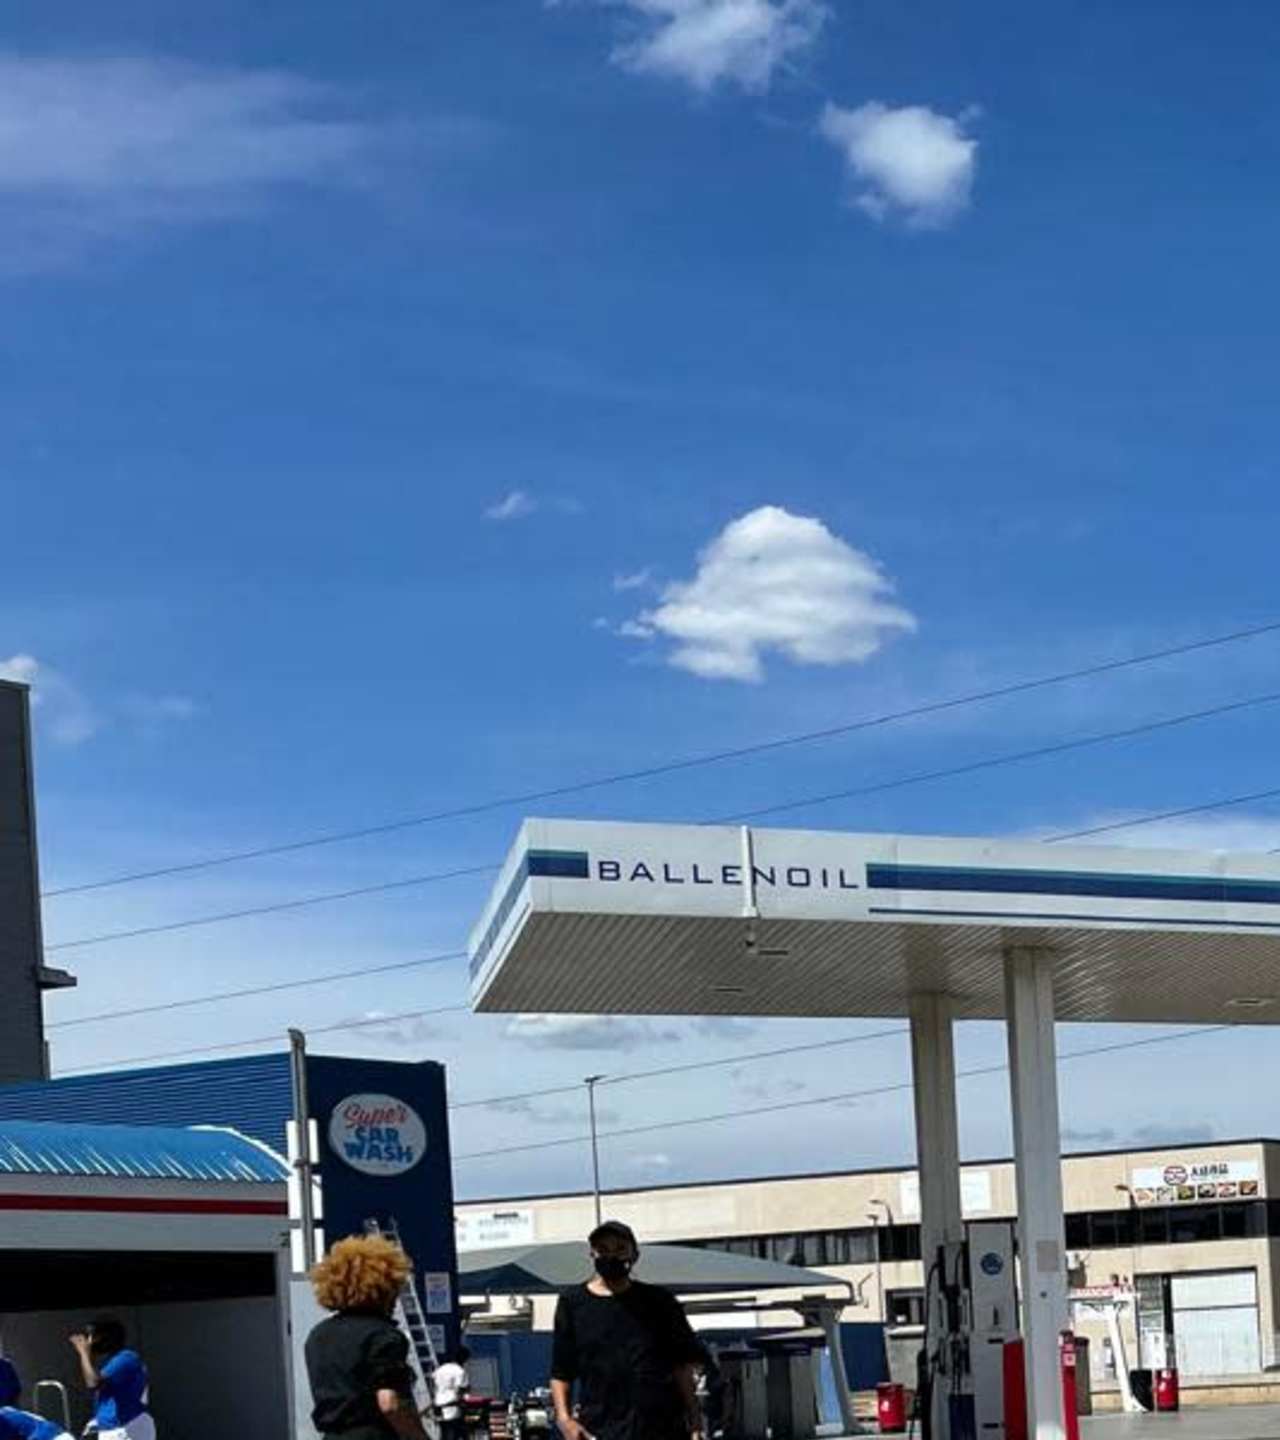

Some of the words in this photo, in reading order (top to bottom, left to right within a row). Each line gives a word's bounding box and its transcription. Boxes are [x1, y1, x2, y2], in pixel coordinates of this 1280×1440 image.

[598, 860, 860, 888] BALLENOIL
[355, 1127, 400, 1143] CAR
[343, 1141, 414, 1163] WASH
